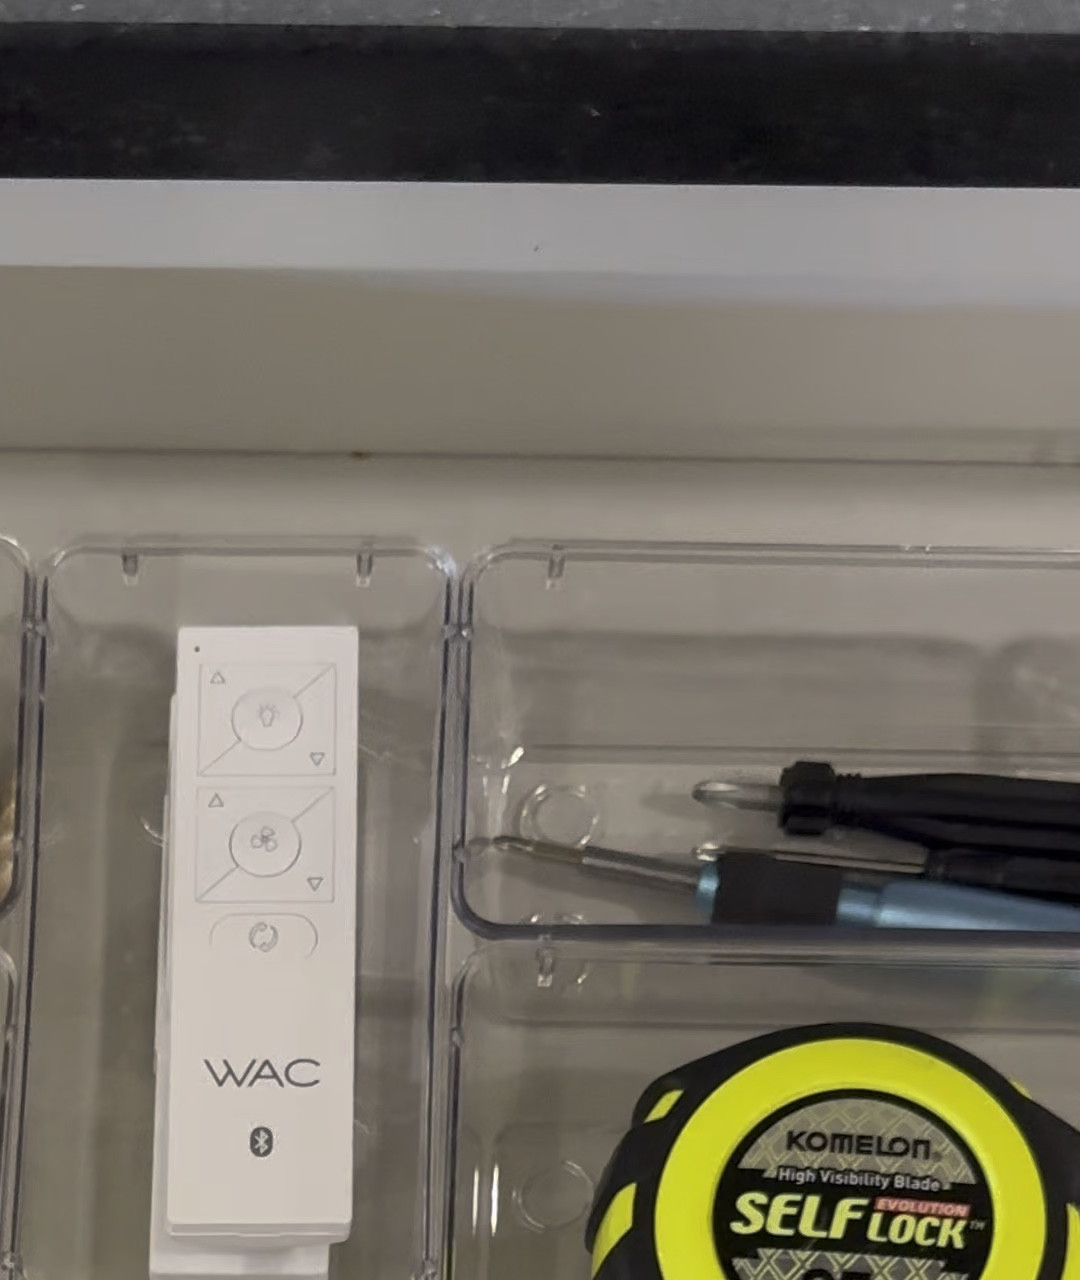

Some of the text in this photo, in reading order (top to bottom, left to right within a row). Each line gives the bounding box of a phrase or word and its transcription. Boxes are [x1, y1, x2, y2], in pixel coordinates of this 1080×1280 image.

[203, 1058, 321, 1088] WAC
[786, 1130, 931, 1160] KOMELON
[777, 1167, 941, 1192] High Visibility Blade
[729, 1191, 870, 1240] SELF
[866, 1211, 969, 1250] LOCK
[876, 1197, 971, 1218] EVOLUTION
